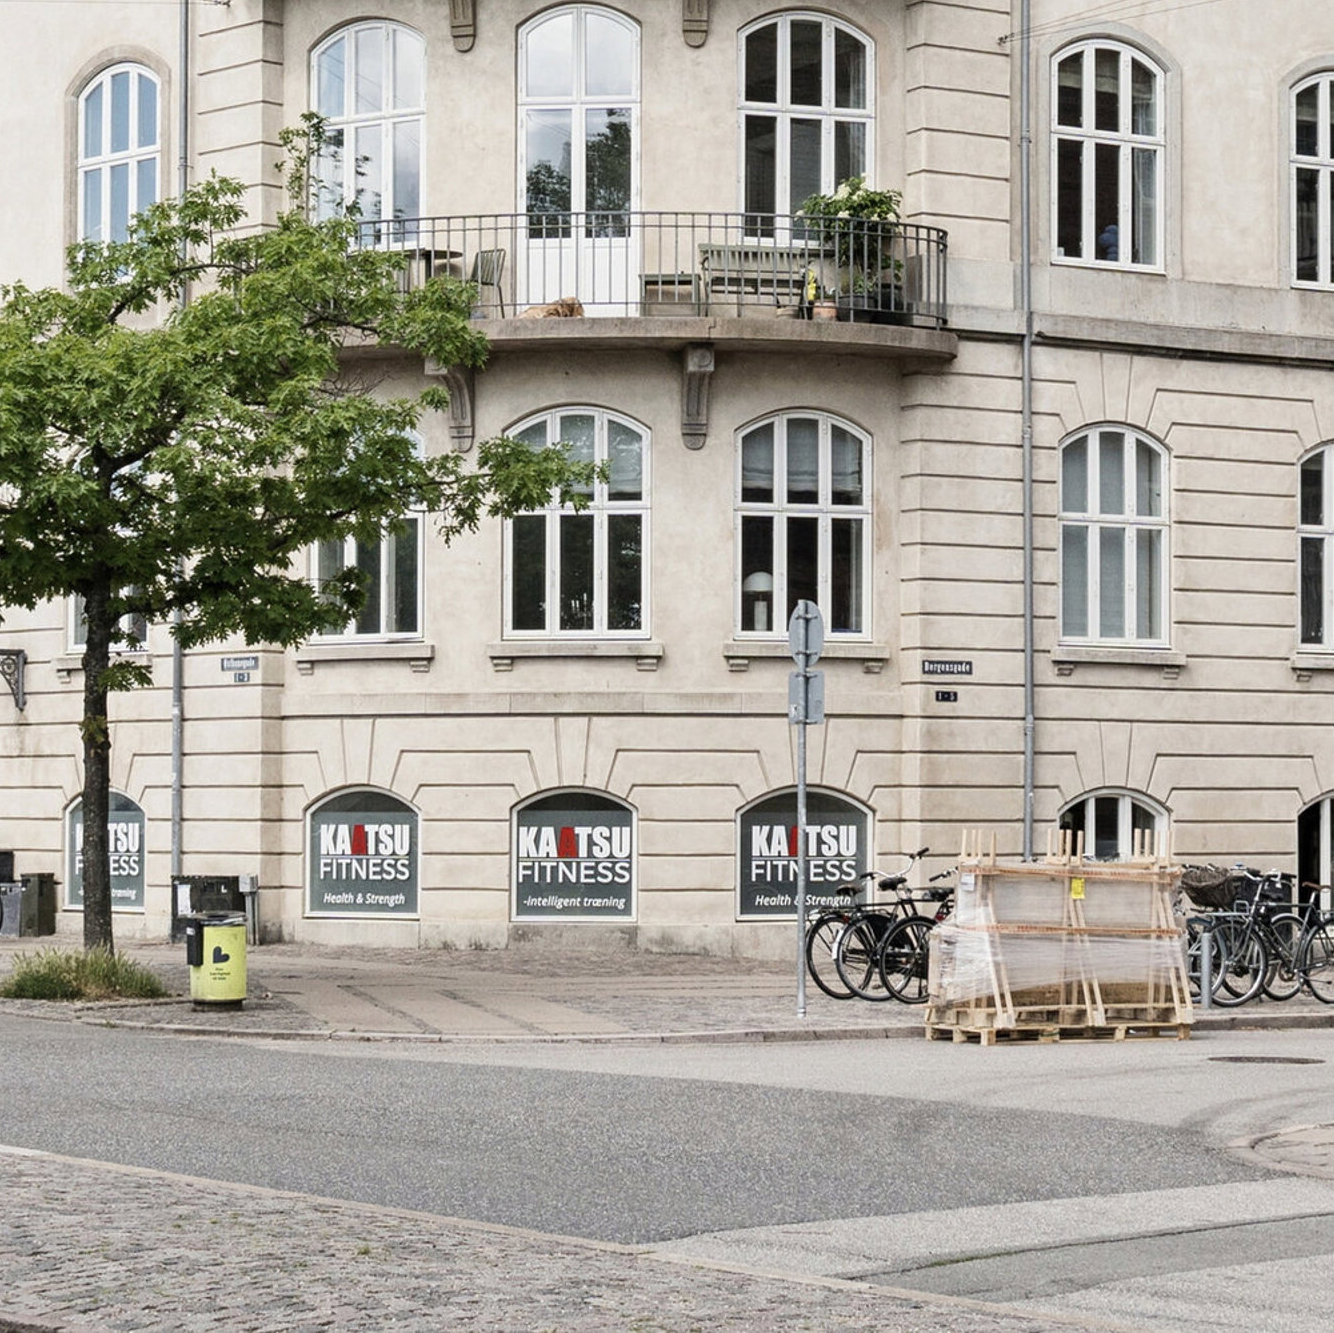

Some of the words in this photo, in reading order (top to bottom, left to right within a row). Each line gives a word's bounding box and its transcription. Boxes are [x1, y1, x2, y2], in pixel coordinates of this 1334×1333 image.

[75, 822, 140, 853] KTSU
[320, 823, 410, 856] KAATSU
[518, 826, 631, 858] KAATSU
[75, 856, 140, 876] FESS
[320, 858, 410, 880] FITNESS
[518, 861, 630, 883] FITNESS
[323, 892, 354, 904] Health
[356, 893, 364, 904] &
[365, 892, 406, 907] Strength
[755, 894, 792, 906] Health
